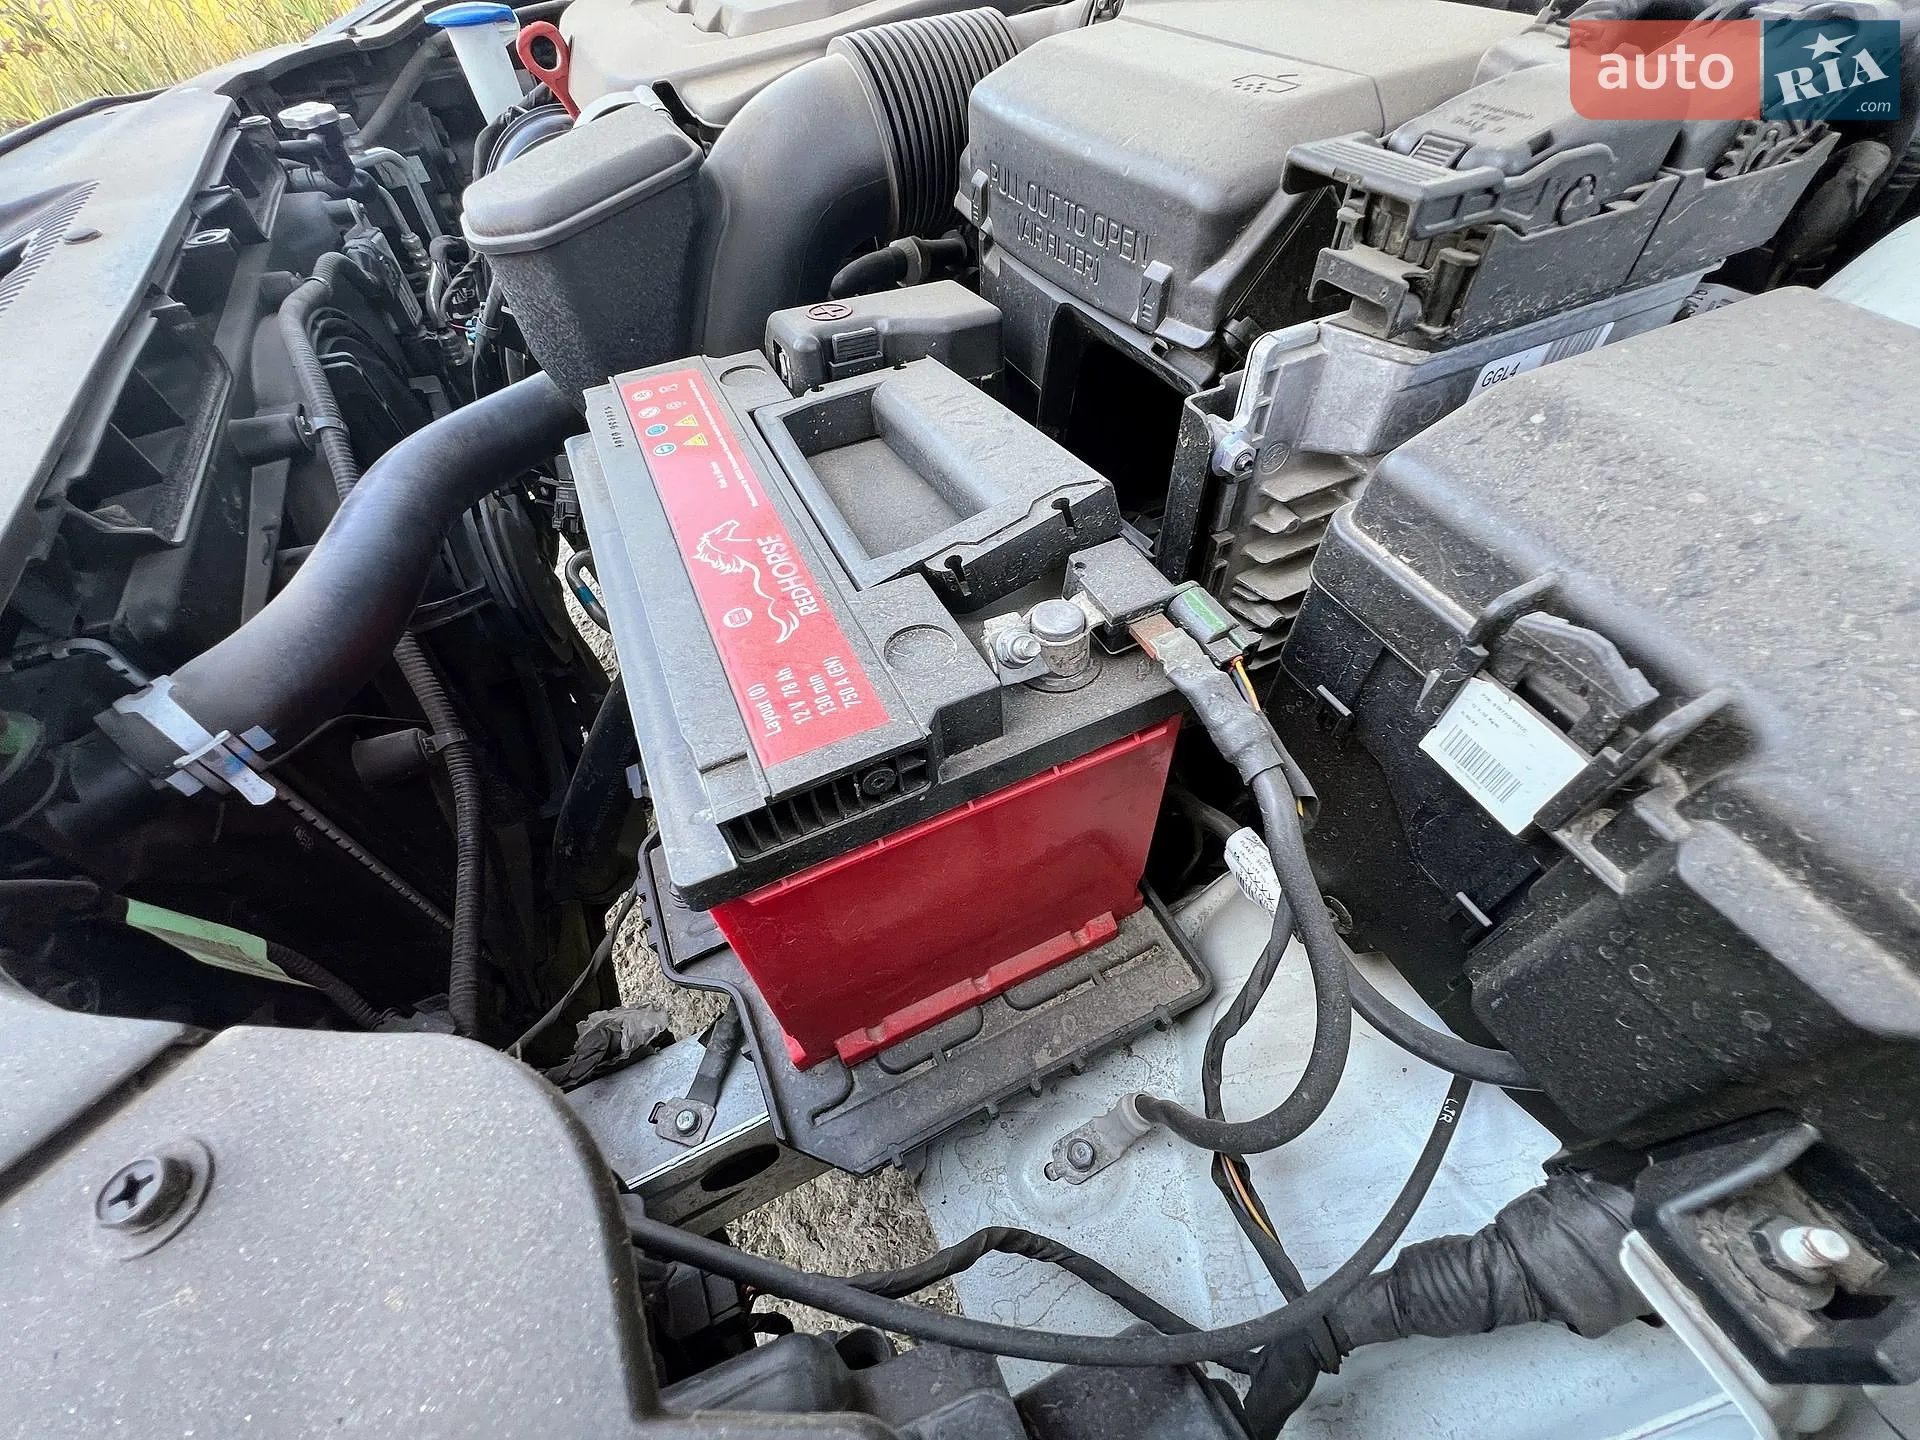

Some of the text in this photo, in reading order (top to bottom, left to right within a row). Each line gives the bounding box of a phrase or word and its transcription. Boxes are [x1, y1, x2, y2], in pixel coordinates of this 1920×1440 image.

[989, 160, 1148, 268] PULL OUT TO OPEN
[1017, 212, 1100, 286] (AIR FILTER)
[1481, 363, 1520, 387] GGL4
[756, 535, 820, 616] REDHORSE
[774, 666, 813, 725] 12 V 78 Ah
[807, 673, 837, 716] 130 min
[822, 656, 862, 709] 750 A (EN)
[755, 699, 782, 737] Layout
